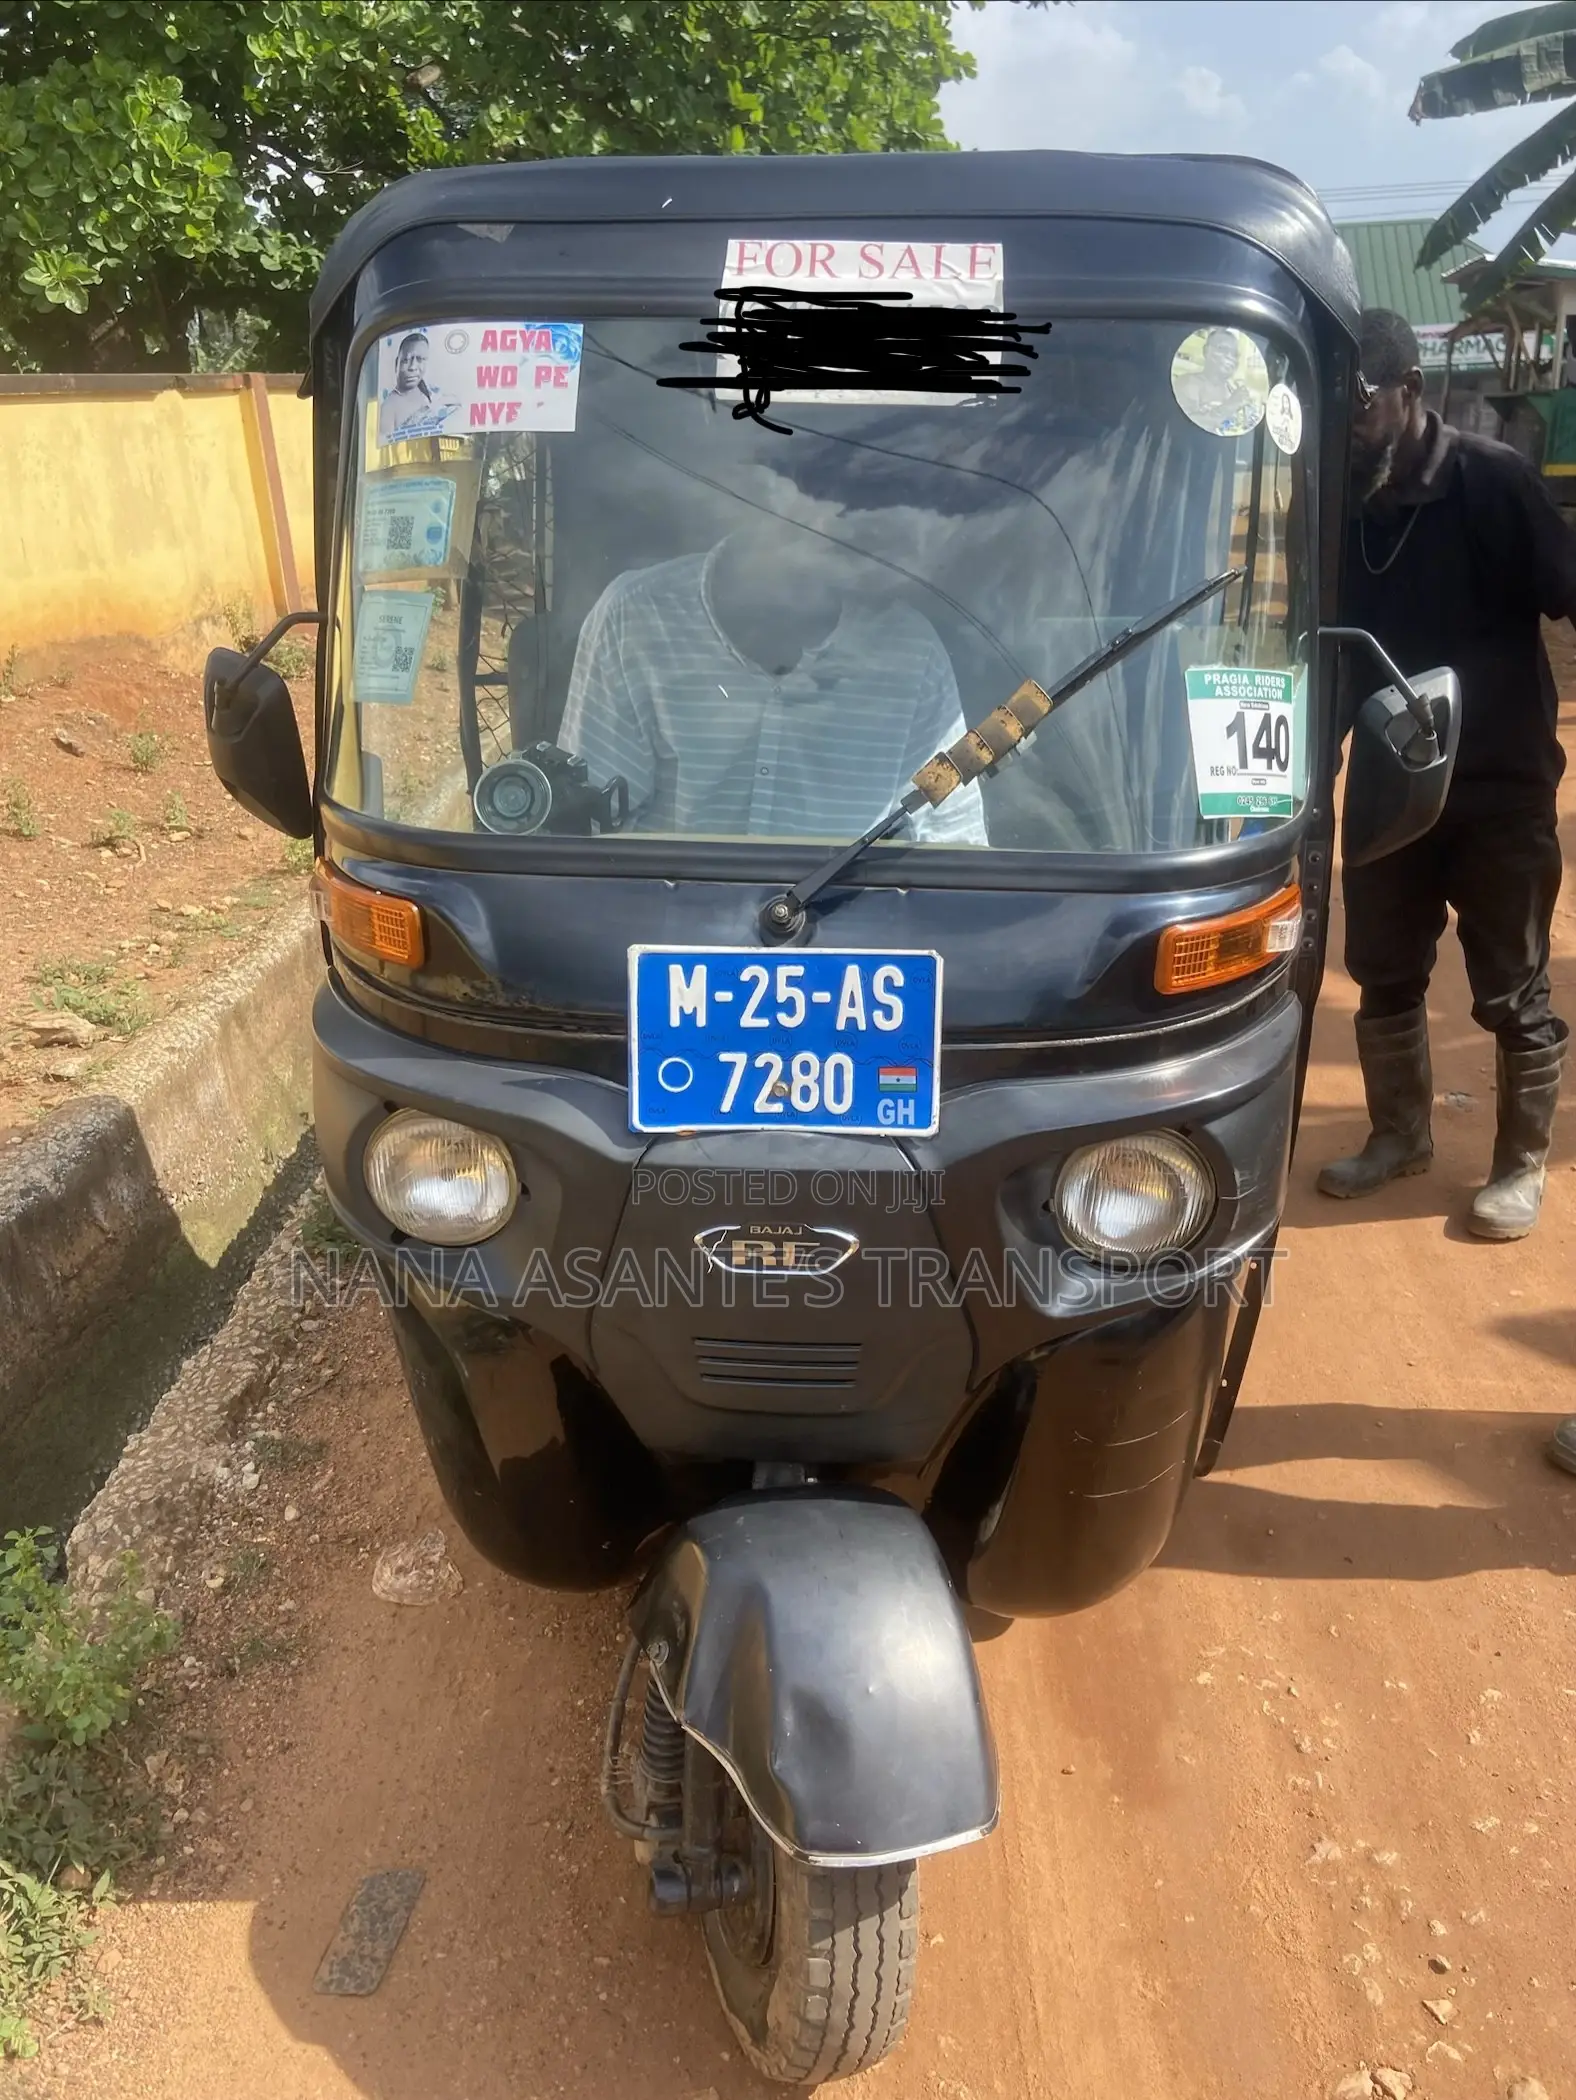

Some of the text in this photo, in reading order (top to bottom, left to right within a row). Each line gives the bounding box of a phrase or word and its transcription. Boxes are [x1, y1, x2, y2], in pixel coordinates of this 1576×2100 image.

[734, 240, 999, 281] FOR SALE
[480, 329, 553, 353] AGYA
[476, 365, 570, 389] WO PE
[1204, 673, 1286, 689] PRAGIA RIDERS
[1215, 685, 1283, 699] ASSOCIATION
[1226, 711, 1290, 772] 140
[1210, 766, 1225, 777] REG
[668, 964, 905, 1031] M-25-AS
[718, 1053, 854, 1115] 7280
[877, 1098, 915, 1125] GH
[749, 1225, 803, 1236] BAJAJ
[732, 1239, 821, 1267] RE
